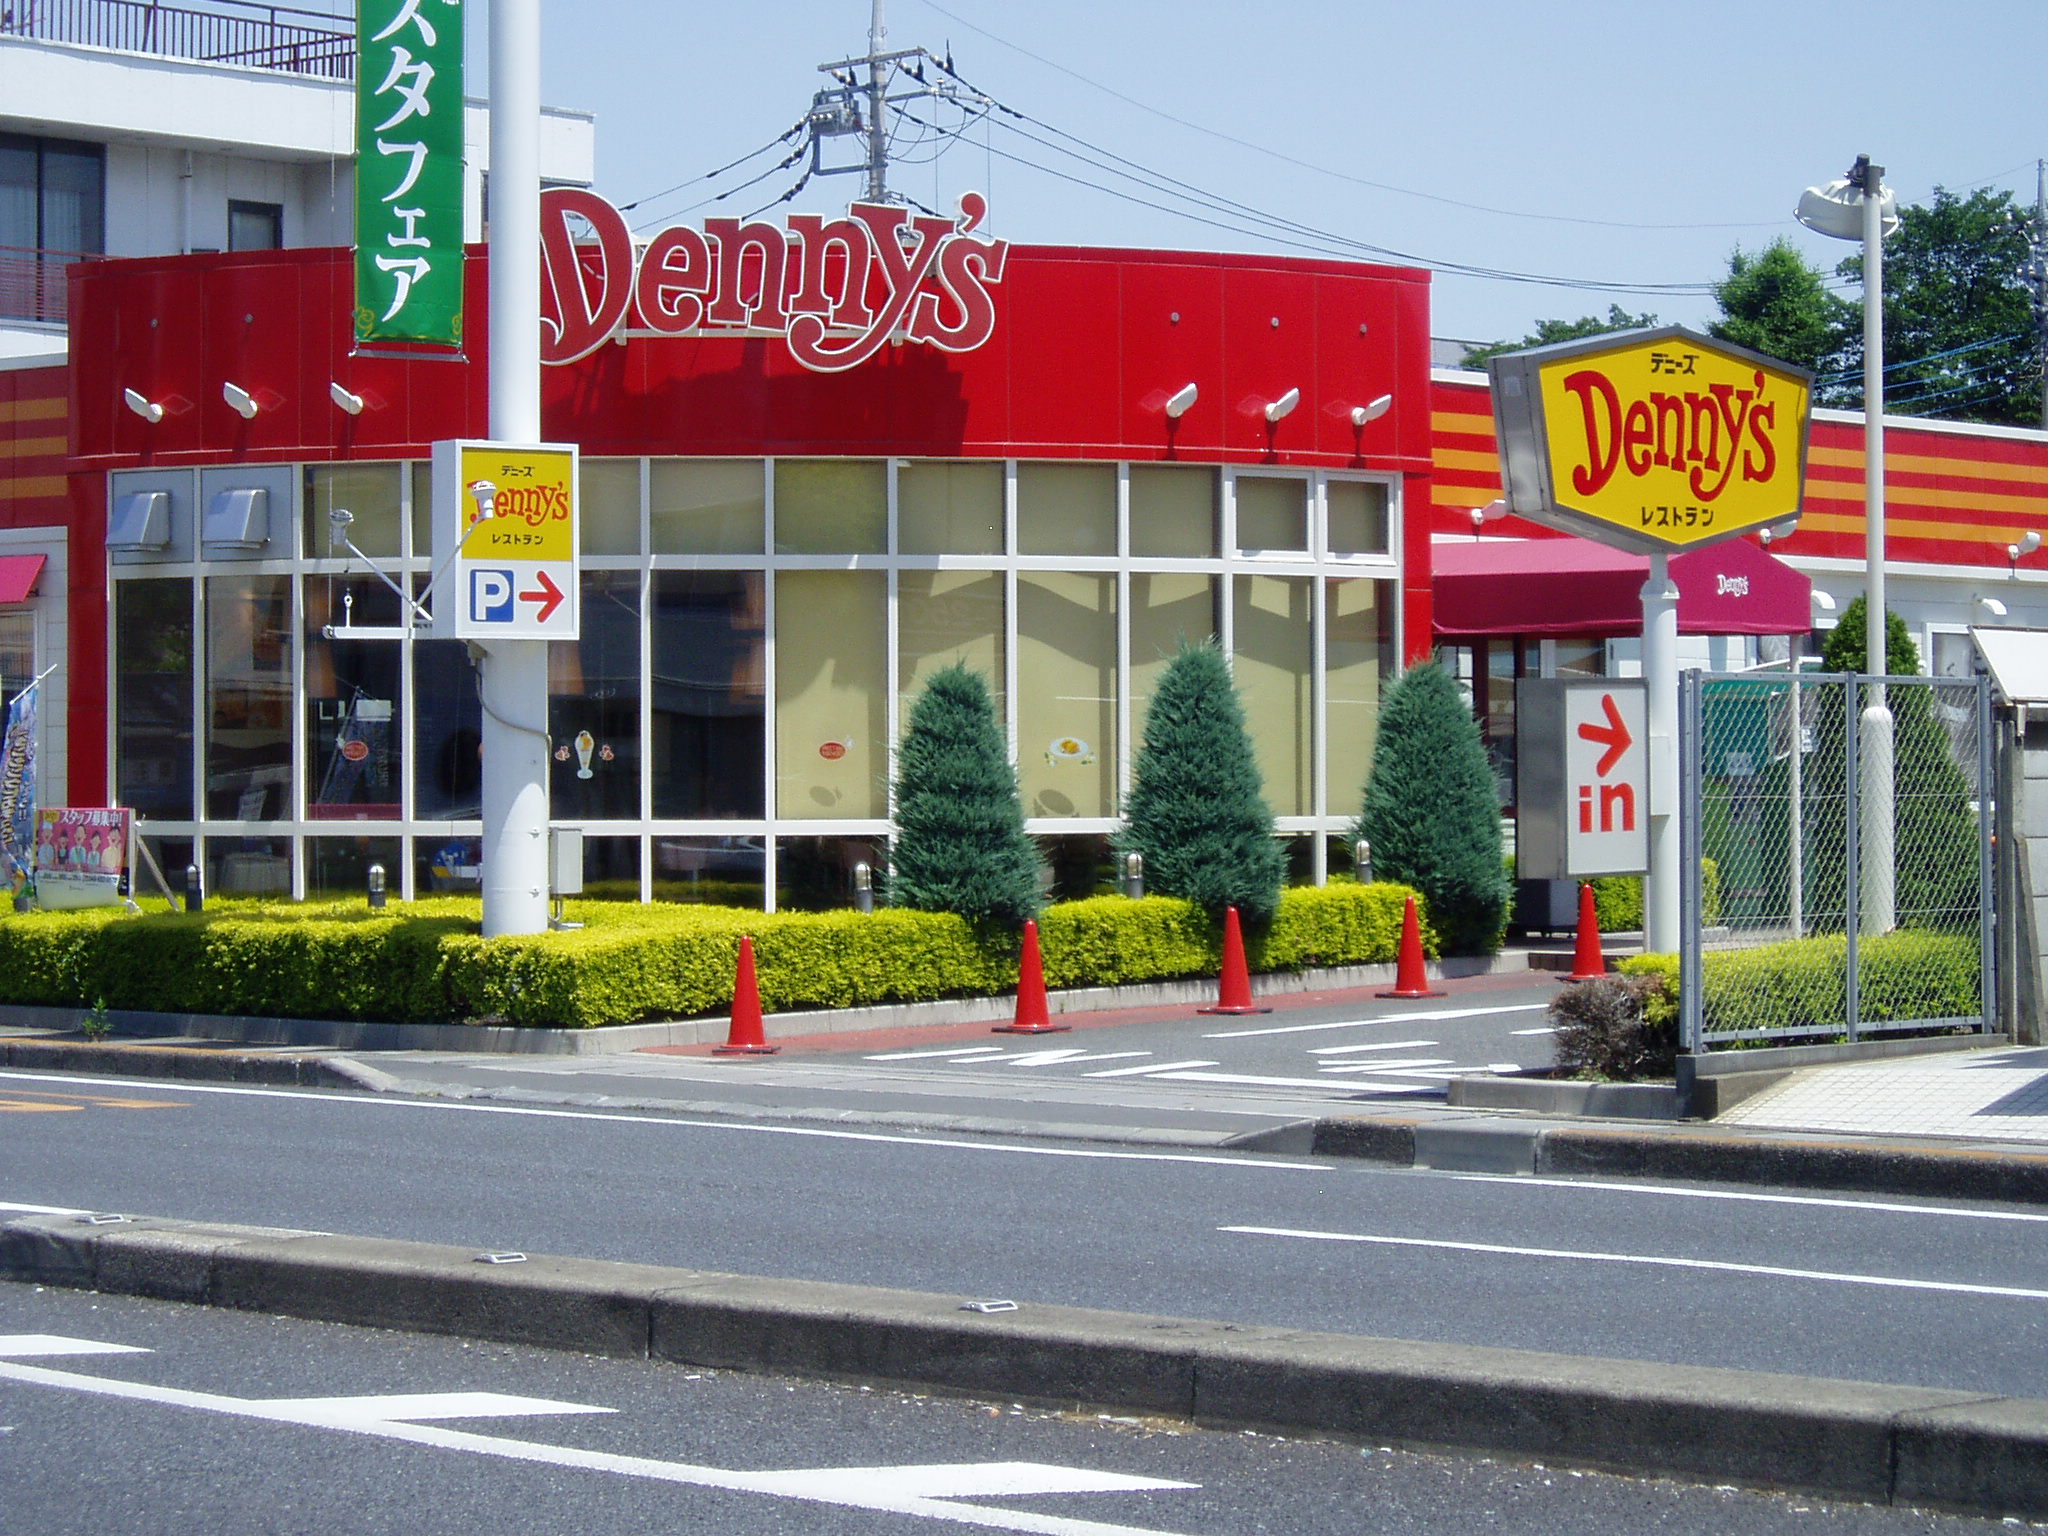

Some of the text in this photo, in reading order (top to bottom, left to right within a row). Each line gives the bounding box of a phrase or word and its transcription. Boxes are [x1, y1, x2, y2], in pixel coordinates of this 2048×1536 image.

[540, 187, 1009, 373] Denny's
[1651, 352, 1699, 375] デニーズ
[1564, 370, 1776, 502] Denny's
[501, 465, 535, 477] デニーズ
[1641, 506, 1714, 527] レストラン
[492, 534, 544, 545] レストラン
[475, 571, 511, 621] P
[1717, 573, 1749, 597] Denny's
[1579, 782, 1636, 833] in
